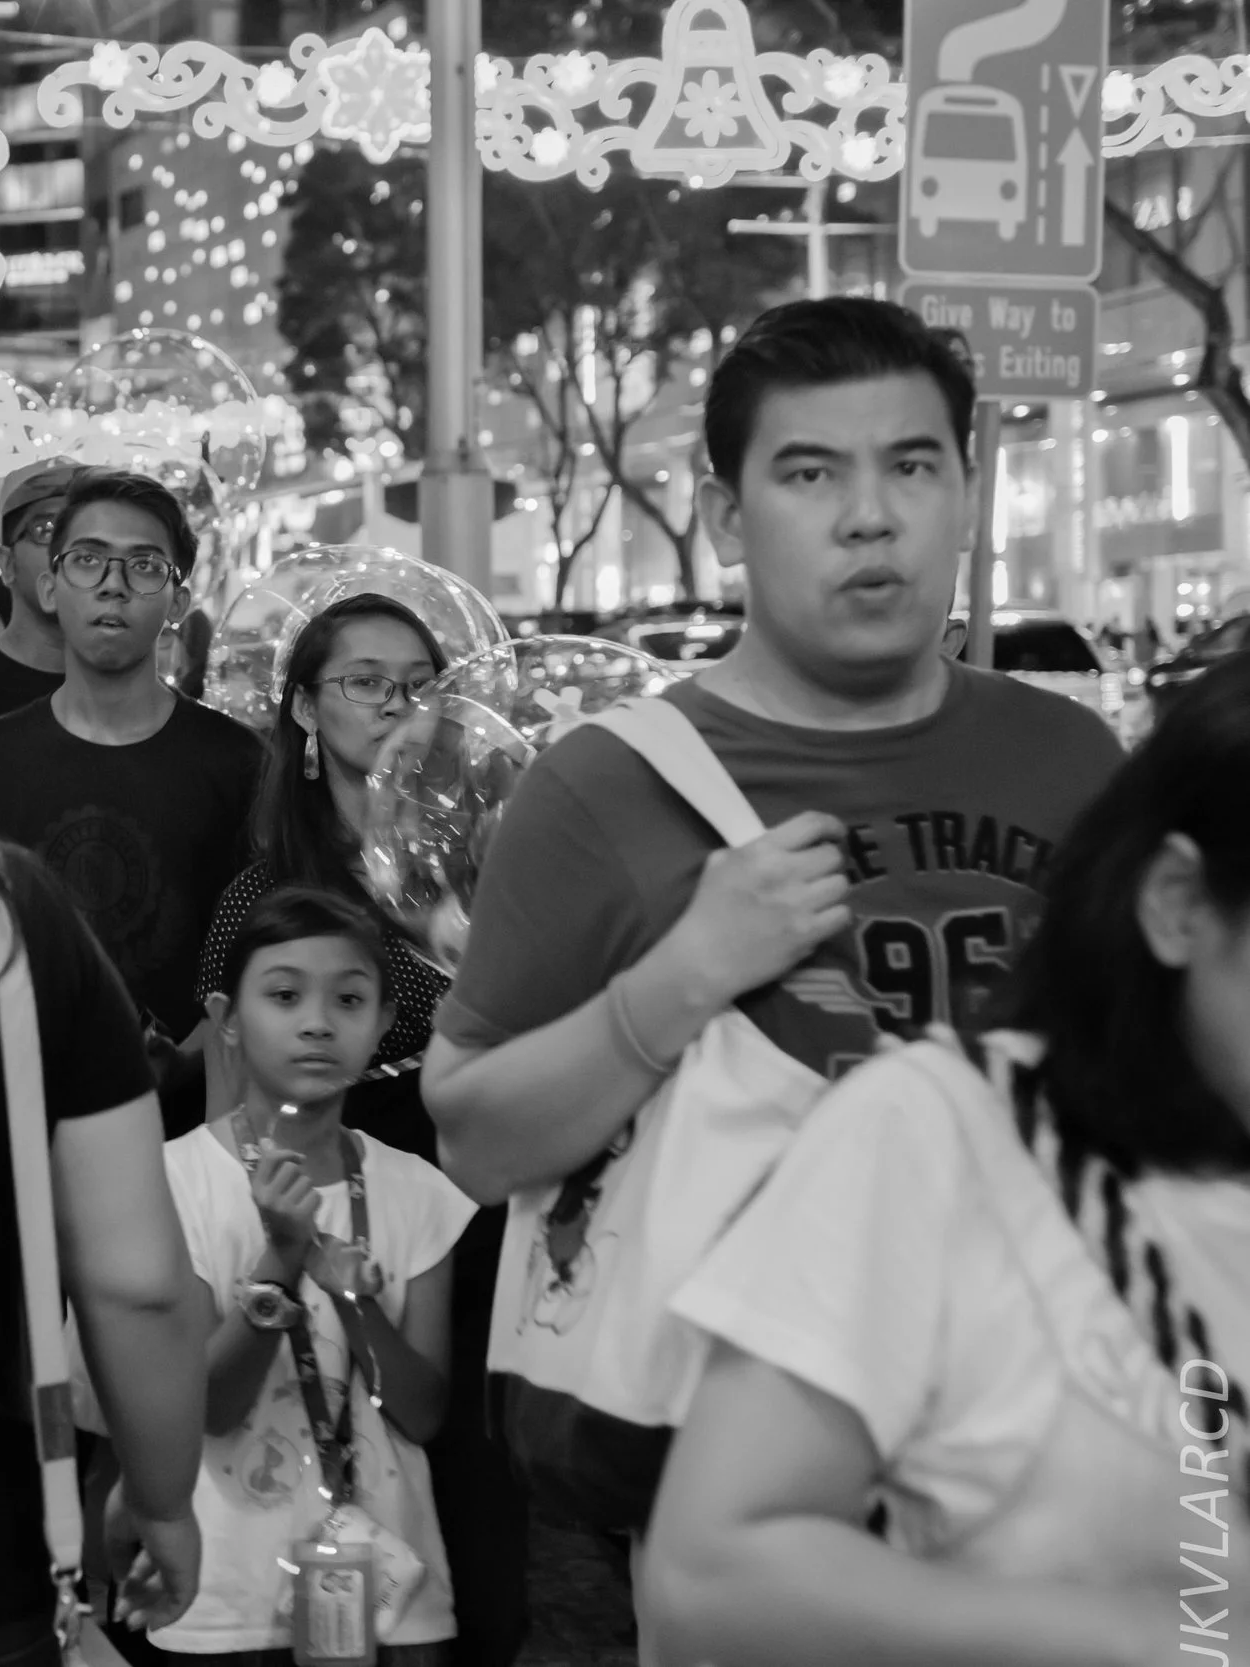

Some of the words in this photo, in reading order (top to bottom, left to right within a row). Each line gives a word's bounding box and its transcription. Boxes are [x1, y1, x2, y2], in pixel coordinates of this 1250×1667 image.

[922, 294, 973, 330] Give
[988, 296, 1036, 340] Way
[1050, 298, 1077, 332] to
[999, 344, 1081, 388] Exiting
